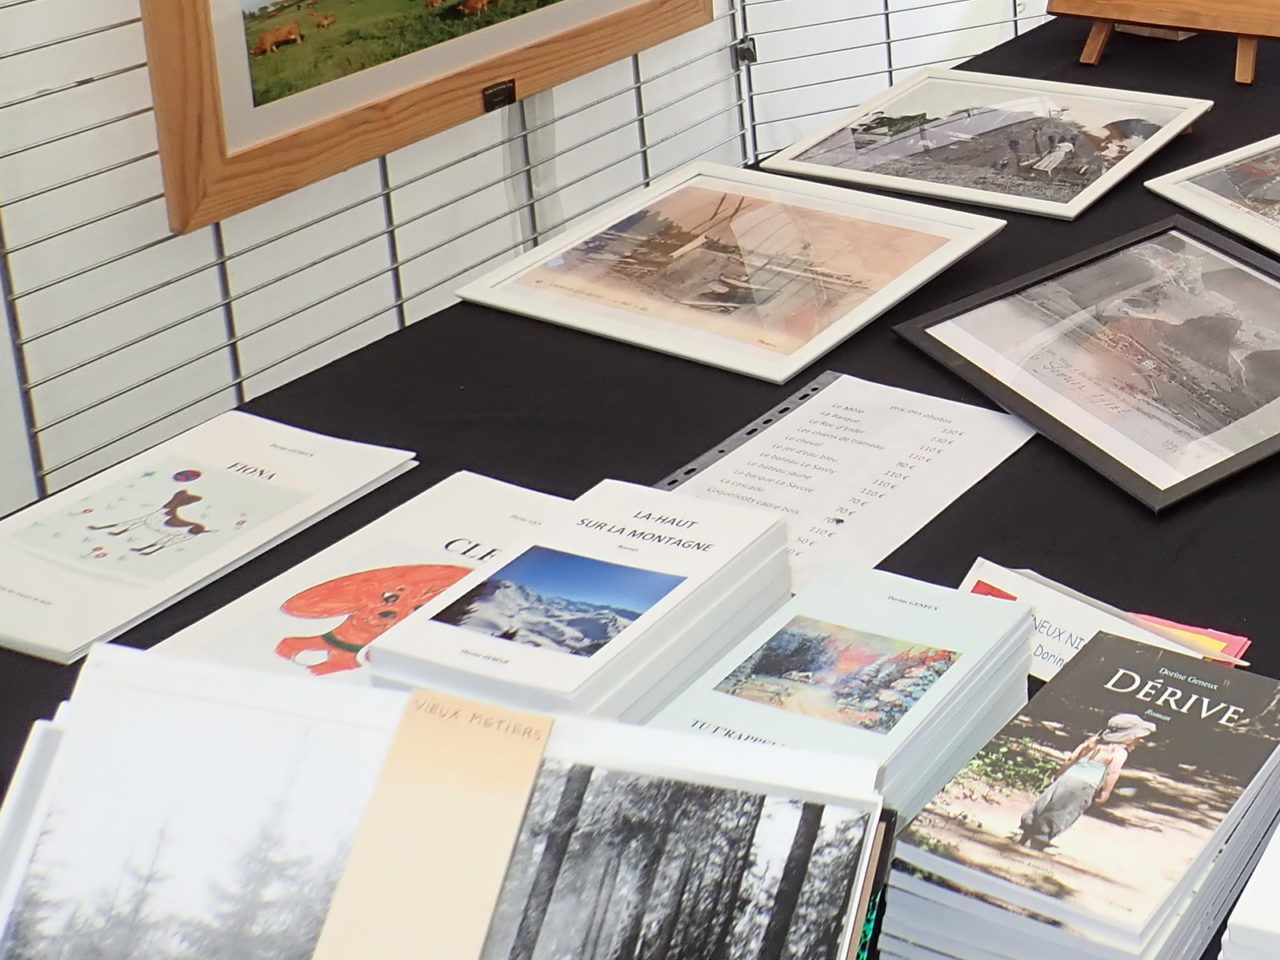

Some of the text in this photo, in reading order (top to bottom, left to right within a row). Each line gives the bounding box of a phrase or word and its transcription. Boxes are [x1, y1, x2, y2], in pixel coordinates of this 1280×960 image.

[922, 412, 952, 424] photos
[908, 453, 925, 462] 110
[227, 461, 277, 482] FIONA
[884, 470, 902, 479] 110
[872, 478, 890, 488] 110
[860, 487, 878, 498] 110
[848, 496, 861, 506] 70
[835, 506, 848, 515] 70
[633, 510, 699, 530] LA-HAUT
[576, 518, 715, 552] SUR LA MONTAGNE
[809, 526, 828, 537] 110
[795, 536, 808, 546] 50
[1032, 614, 1066, 642] NEUX
[1033, 643, 1065, 668] Dorin
[1158, 666, 1219, 691] Dorine Geneux
[1104, 668, 1245, 727] DÉRIVE
[415, 698, 461, 720] VIEUX
[1144, 708, 1172, 722] Roman
[691, 718, 712, 730] TU
